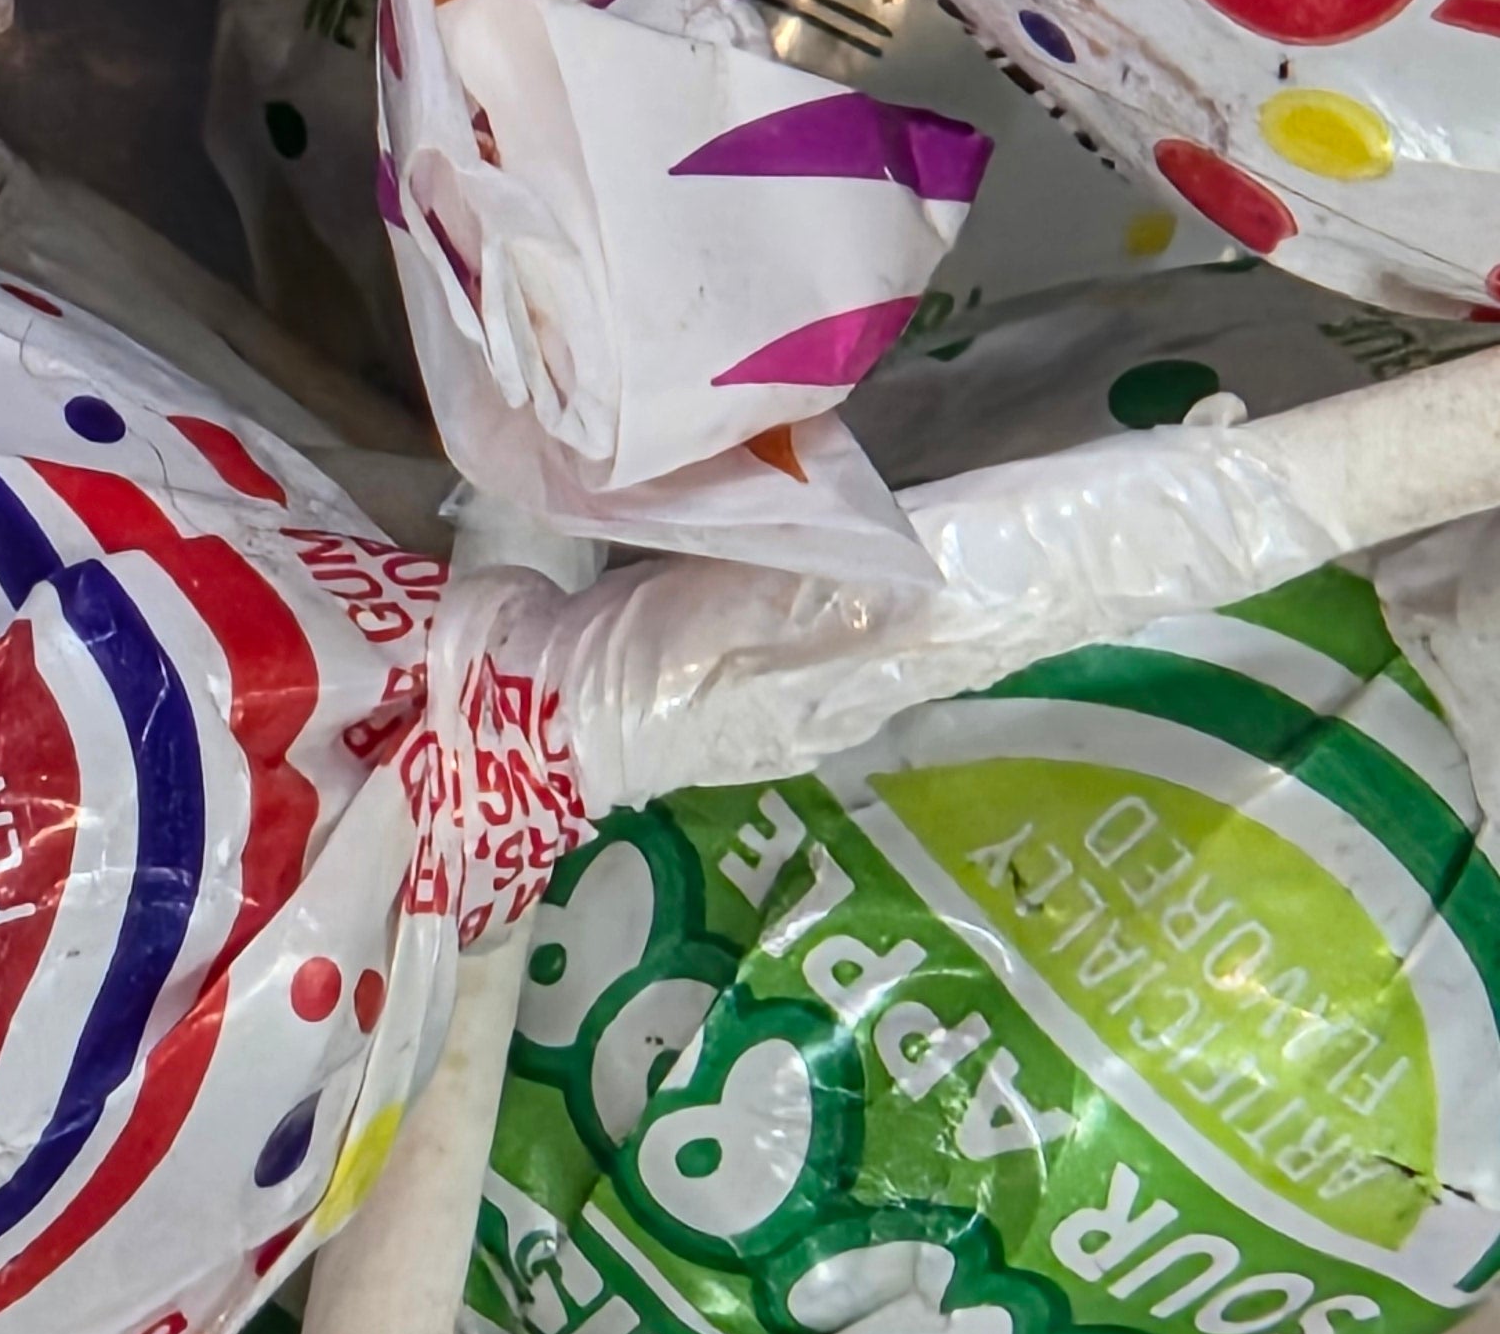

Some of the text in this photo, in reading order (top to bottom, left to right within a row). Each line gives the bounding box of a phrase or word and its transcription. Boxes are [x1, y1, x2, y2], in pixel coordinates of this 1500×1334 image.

[718, 787, 1080, 1162] APPLE
[966, 823, 1392, 1200] ARTIFICIALLY
[1084, 795, 1408, 1115] FLAVORED
